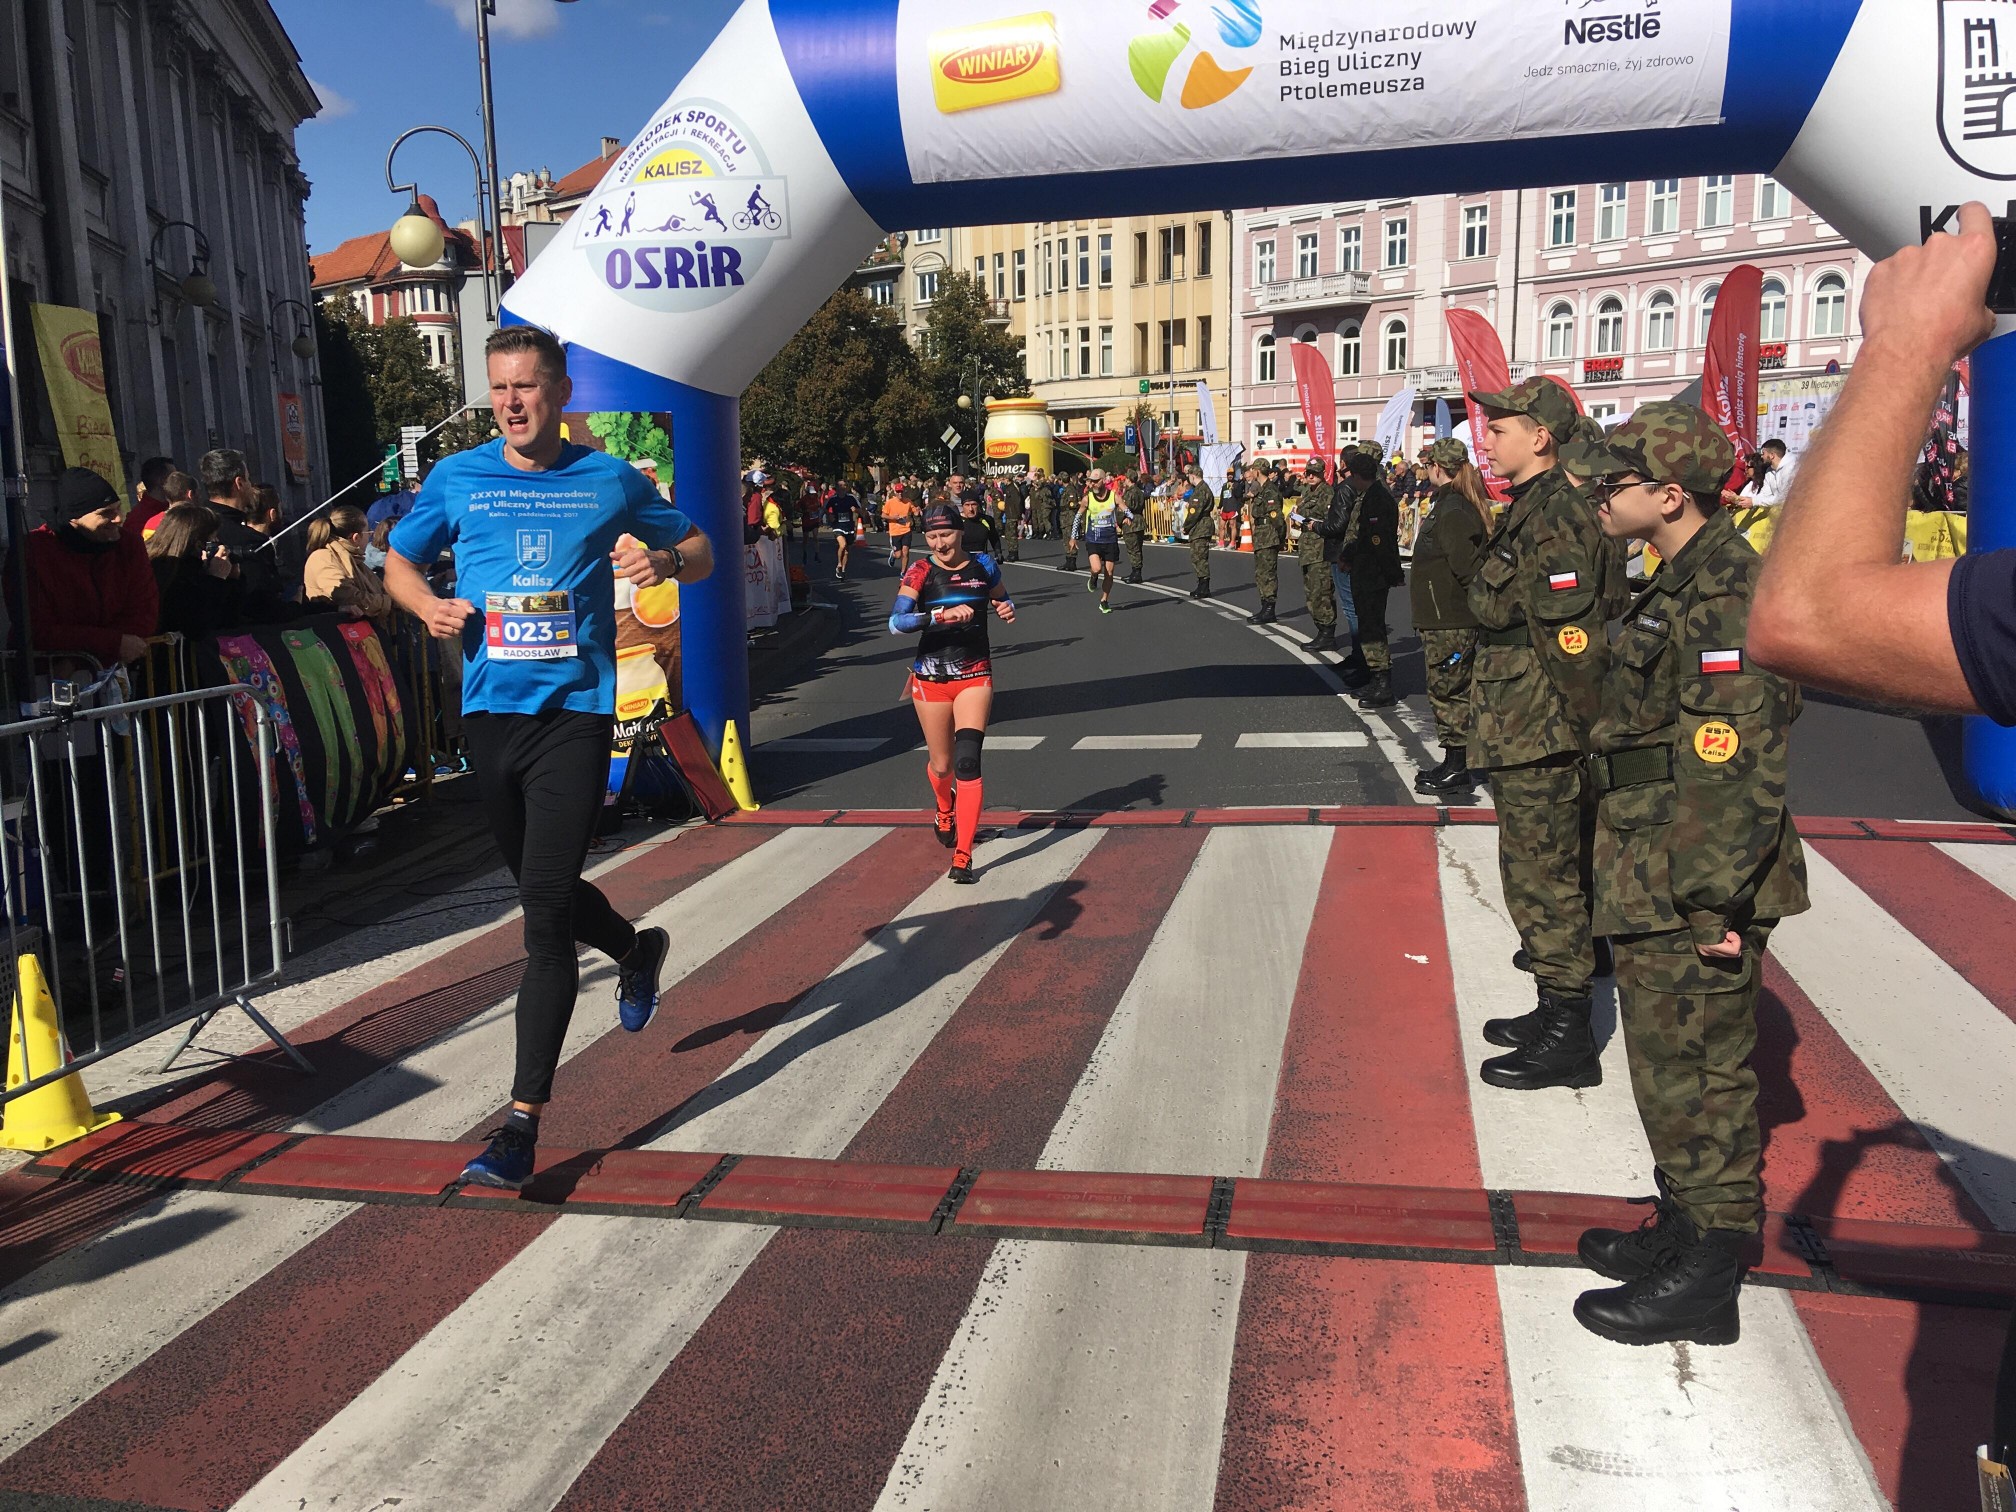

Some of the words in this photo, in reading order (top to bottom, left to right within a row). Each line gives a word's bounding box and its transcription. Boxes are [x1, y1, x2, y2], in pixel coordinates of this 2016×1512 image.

[1280, 19, 1477, 53] Międzynarodowy
[957, 41, 1044, 77] WINIARY
[1280, 57, 1330, 78] Bieg
[1337, 50, 1422, 73] Uliczny
[1557, 59, 1620, 75] smacznie,
[1625, 57, 1642, 71] żyj
[1646, 55, 1694, 68] zdrowo
[1280, 76, 1425, 101] Ptolemeusza
[686, 110, 747, 155] SPORTU
[619, 128, 679, 183] REHABILITACJI
[690, 128, 737, 173] REKREACJI
[644, 160, 702, 178] KALISZ
[1737, 332, 1748, 365] historią
[1584, 357, 1624, 371] ERGO
[1737, 367, 1746, 396] swoją
[1717, 375, 1732, 427] Kalisz
[1736, 398, 1744, 429] Dopisz
[1128, 428, 1134, 440] P
[470, 490, 506, 500] XXXVII
[509, 490, 598, 499] Międzynarodowy
[469, 502, 490, 512] Bieg
[493, 501, 531, 510] Uliczny
[535, 501, 599, 509] Ptolemeusza
[512, 574, 553, 587] Kalisz
[504, 621, 553, 643] 023
[503, 648, 560, 658] RADOSŁAW
[622, 701, 648, 711] WINIARY
[1702, 748, 1727, 757] Kalisz
